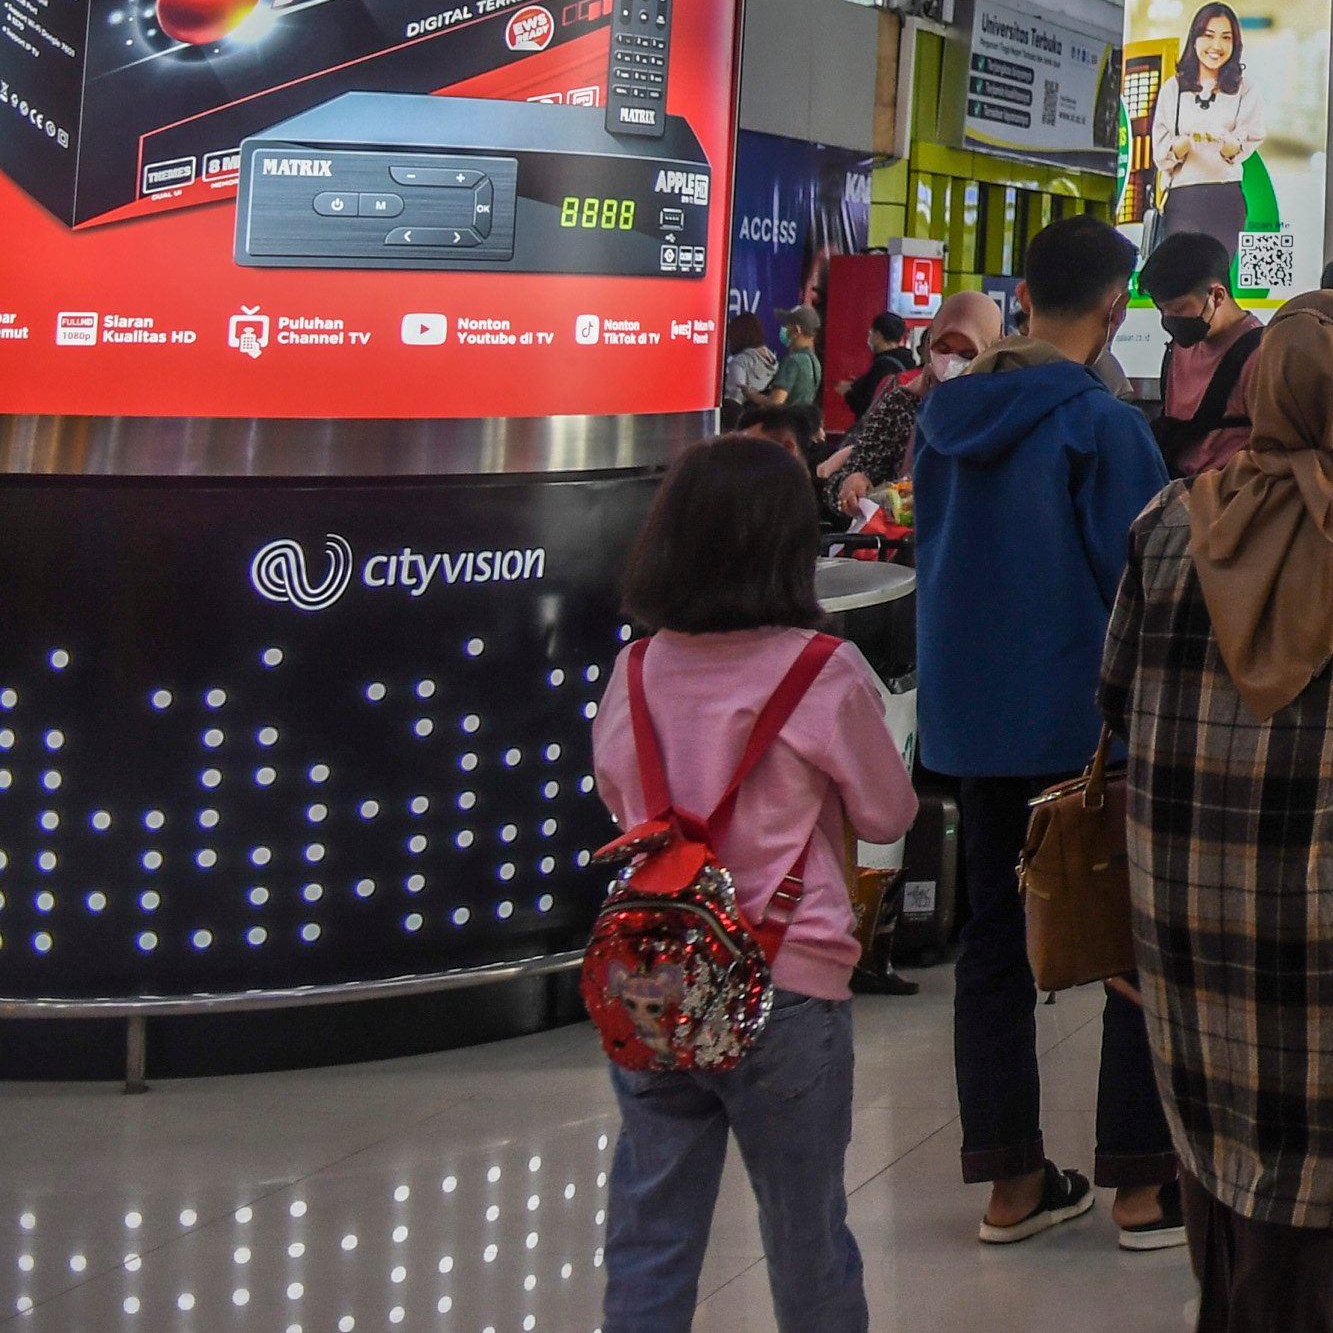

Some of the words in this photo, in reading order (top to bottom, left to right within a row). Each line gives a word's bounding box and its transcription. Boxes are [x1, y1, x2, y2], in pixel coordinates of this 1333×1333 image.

[406, 7, 472, 38] DIGITAL
[981, 12, 1029, 45] Universitas
[620, 107, 655, 124] MATRIX
[262, 158, 332, 177] MATRIX
[561, 196, 635, 229] 8888
[739, 216, 797, 245] ACCESS
[104, 315, 153, 329] Siaran
[278, 316, 343, 331] Puluhan
[458, 318, 510, 331] Nonton
[603, 319, 640, 332] Nonton
[103, 329, 166, 344] Kualitas
[171, 331, 196, 344] HD
[278, 332, 343, 345] Channel
[348, 332, 371, 345] TV
[457, 331, 516, 346] Youtube
[536, 333, 554, 344] TV
[603, 332, 636, 346] TikTok
[648, 333, 660, 345] TV
[363, 546, 546, 596] cityvision
